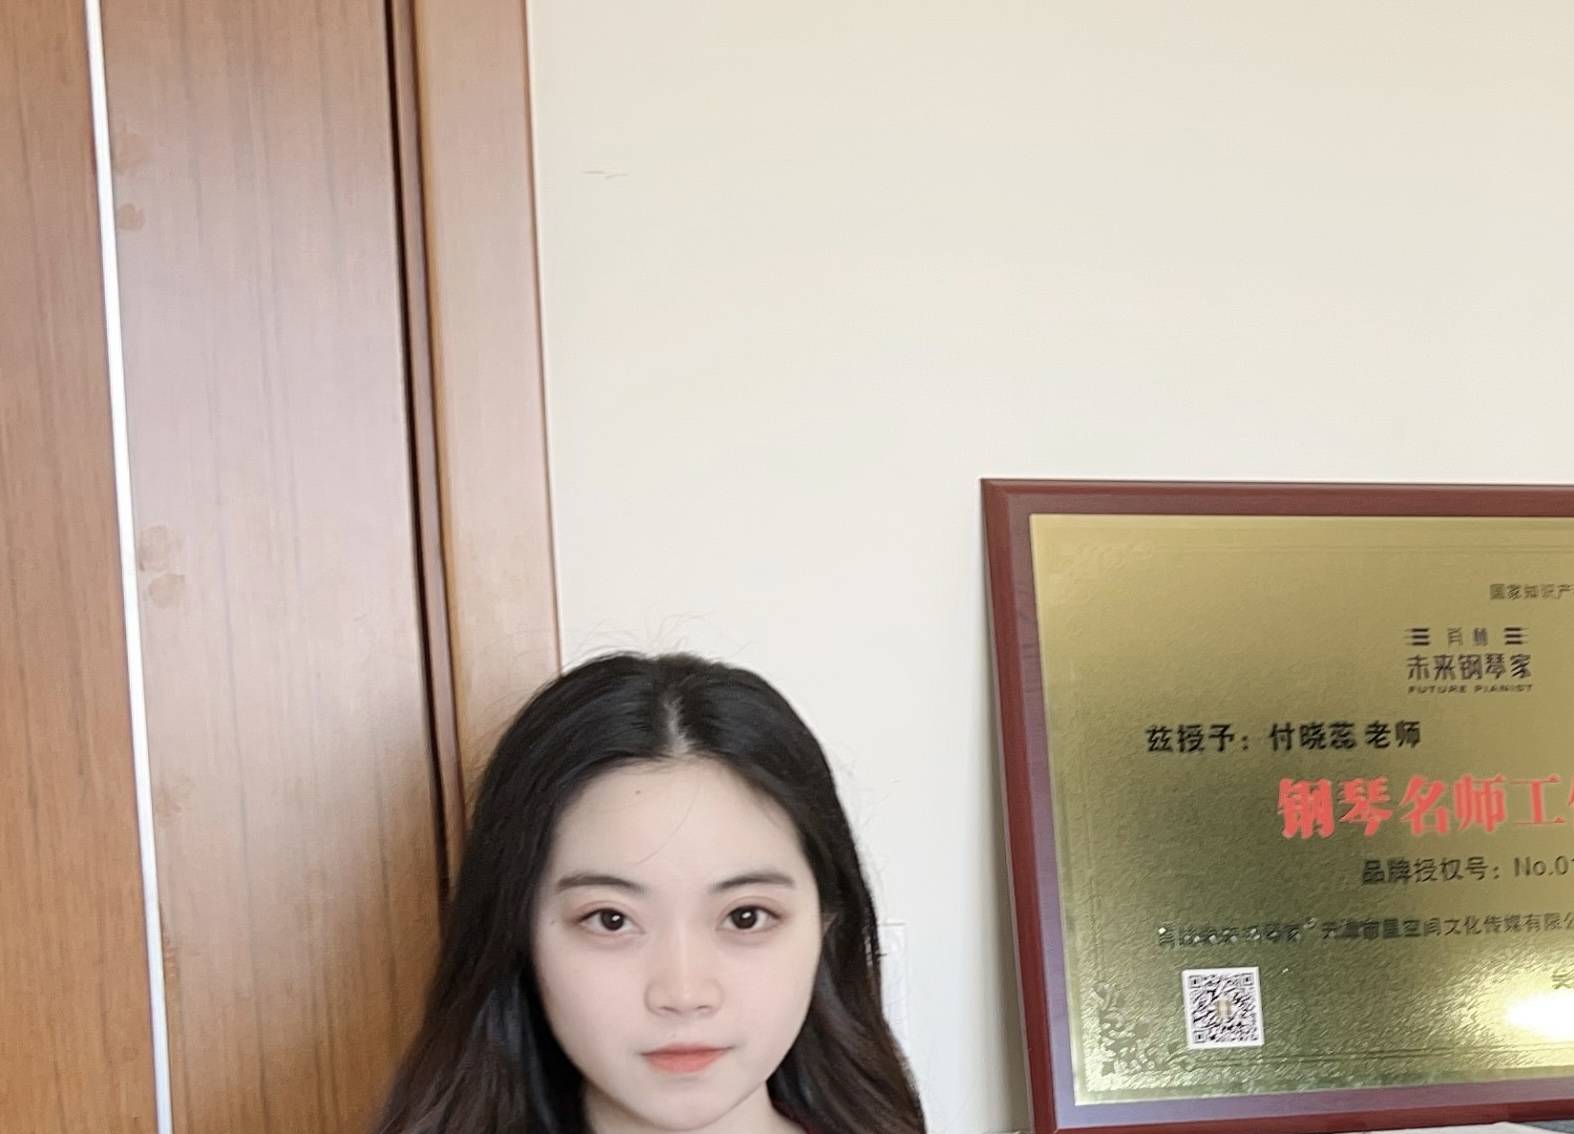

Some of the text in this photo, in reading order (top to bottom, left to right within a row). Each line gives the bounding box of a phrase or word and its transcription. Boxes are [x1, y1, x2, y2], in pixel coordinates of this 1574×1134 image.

[1407, 653, 1531, 681] 未来钢琴家
[1408, 684, 1532, 693] FUTURE PIANIST
